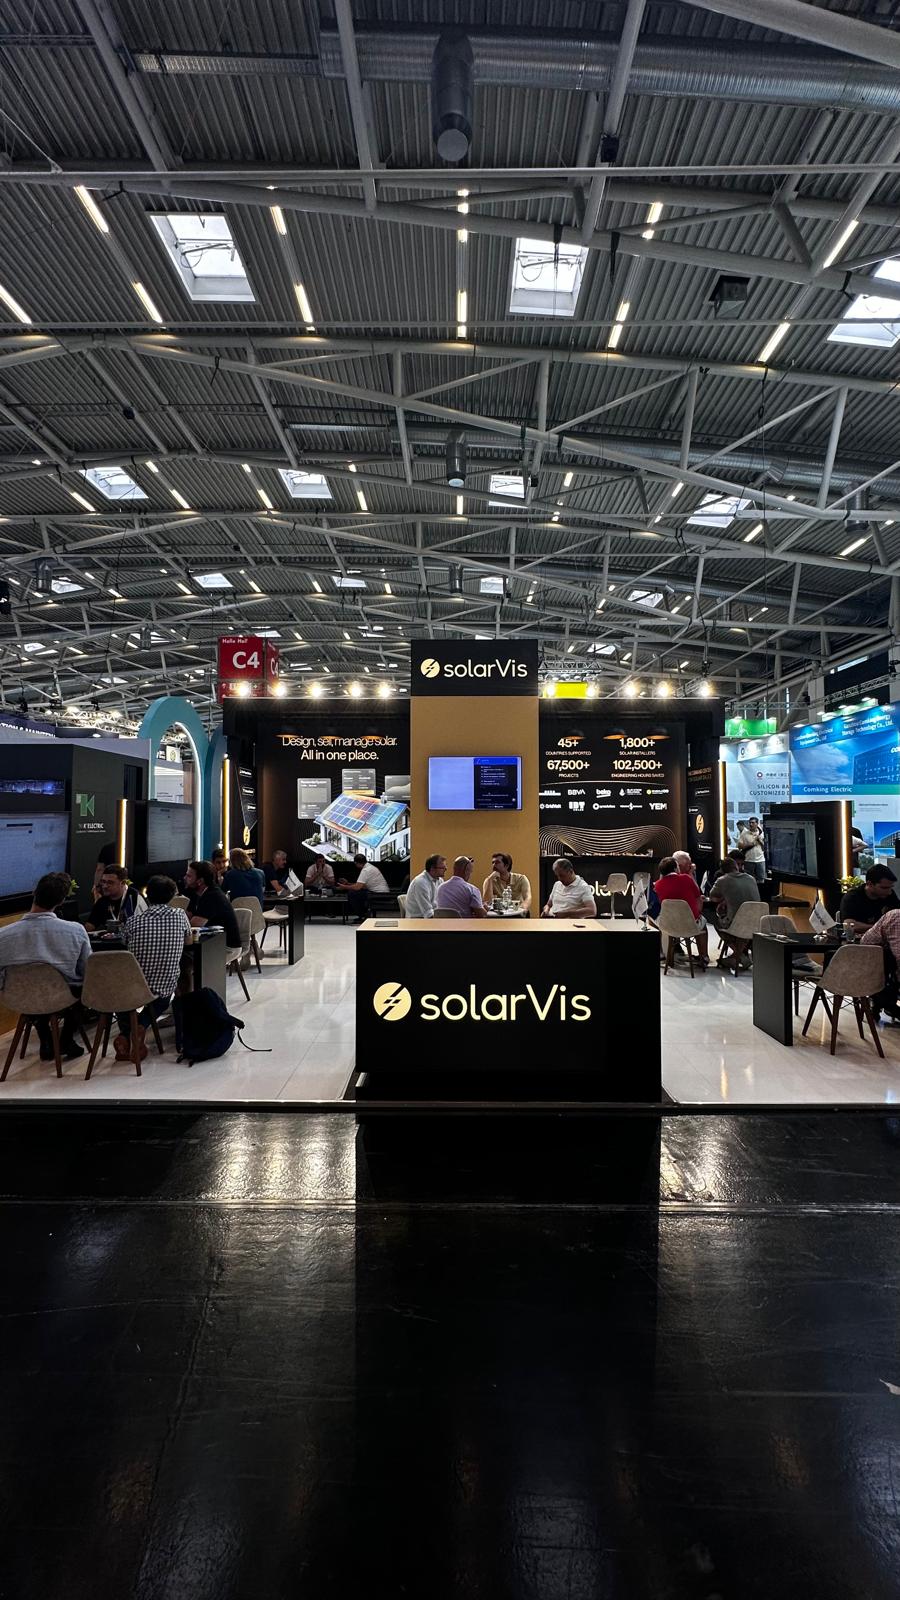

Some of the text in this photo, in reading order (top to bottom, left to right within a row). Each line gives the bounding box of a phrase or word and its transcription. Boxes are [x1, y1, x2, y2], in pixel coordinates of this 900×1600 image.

[232, 651, 260, 669] C4
[443, 659, 528, 678] solarVis
[282, 736, 316, 748] Design,
[334, 738, 375, 748] manage
[376, 736, 398, 746] solar.
[557, 738, 579, 748] 45+
[619, 737, 656, 749] 1,800+
[300, 750, 379, 761] All in one place.
[547, 760, 590, 771] 67,500+
[613, 760, 663, 771] 102,500+
[420, 984, 592, 1021] solarVis
